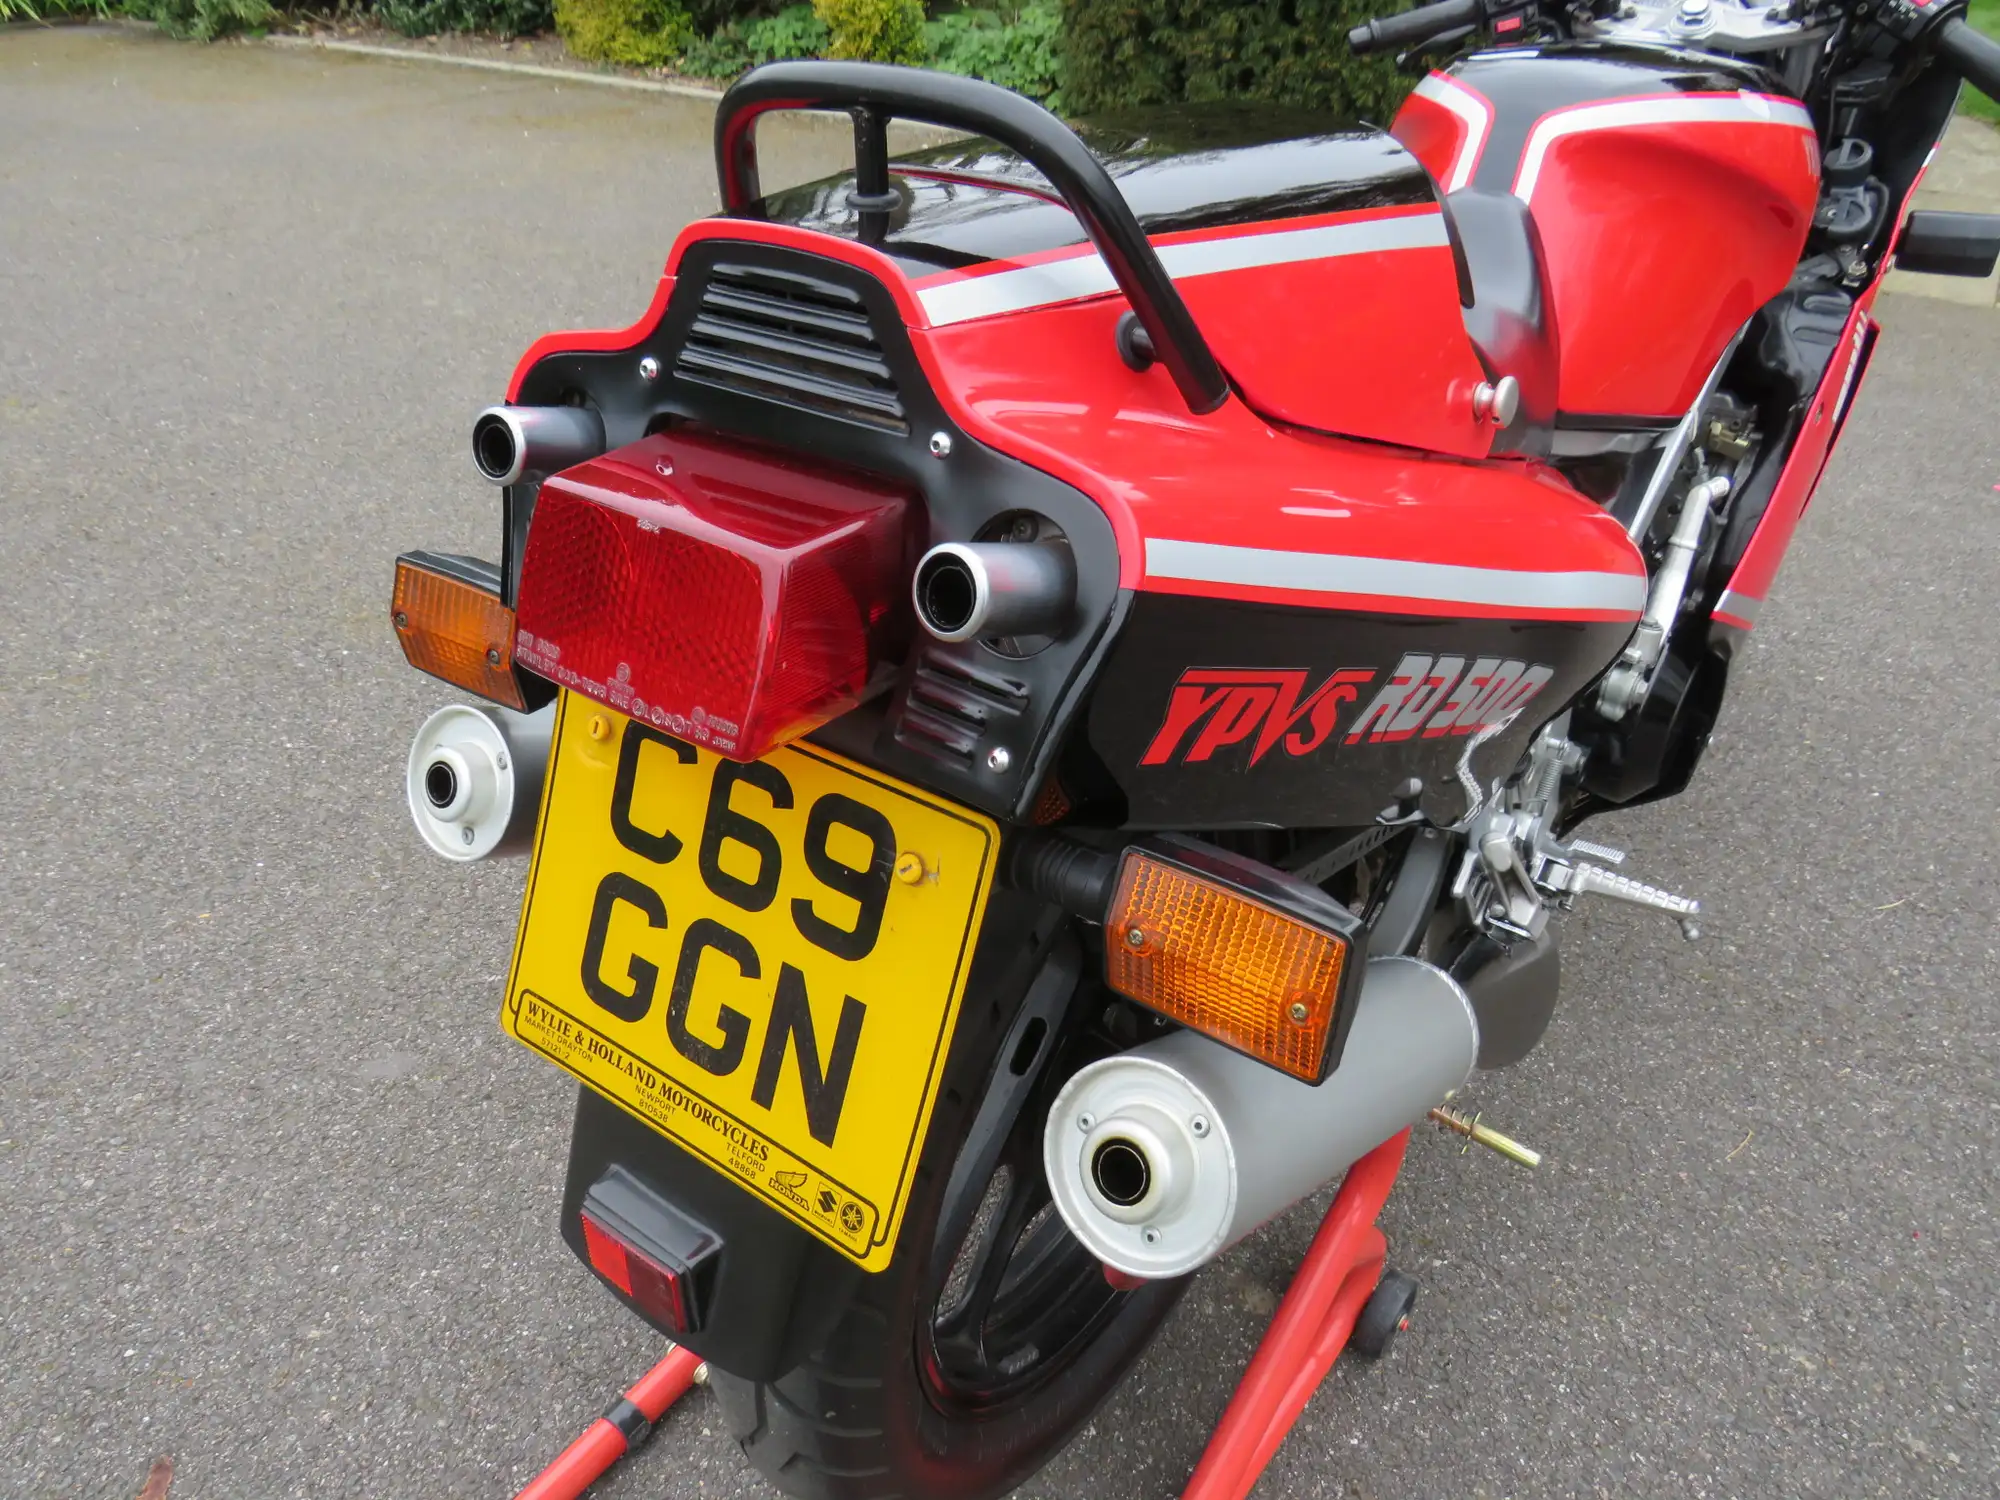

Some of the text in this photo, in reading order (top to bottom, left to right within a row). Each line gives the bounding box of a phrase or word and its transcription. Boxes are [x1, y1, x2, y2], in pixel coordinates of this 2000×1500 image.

[1138, 667, 1377, 771] YPVS
[610, 719, 897, 962] C69
[581, 872, 867, 1149] GGN
[524, 1015, 593, 1063] MARKET DRAYTON
[528, 1000, 770, 1162] WYLIE & HOLLAND MOTORCYCLES
[635, 1084, 676, 1115] NEWPORT
[639, 1098, 669, 1123] 810538
[726, 1142, 766, 1172] TELFORD
[728, 1157, 756, 1180] 48868
[768, 1177, 809, 1211] HONDA
